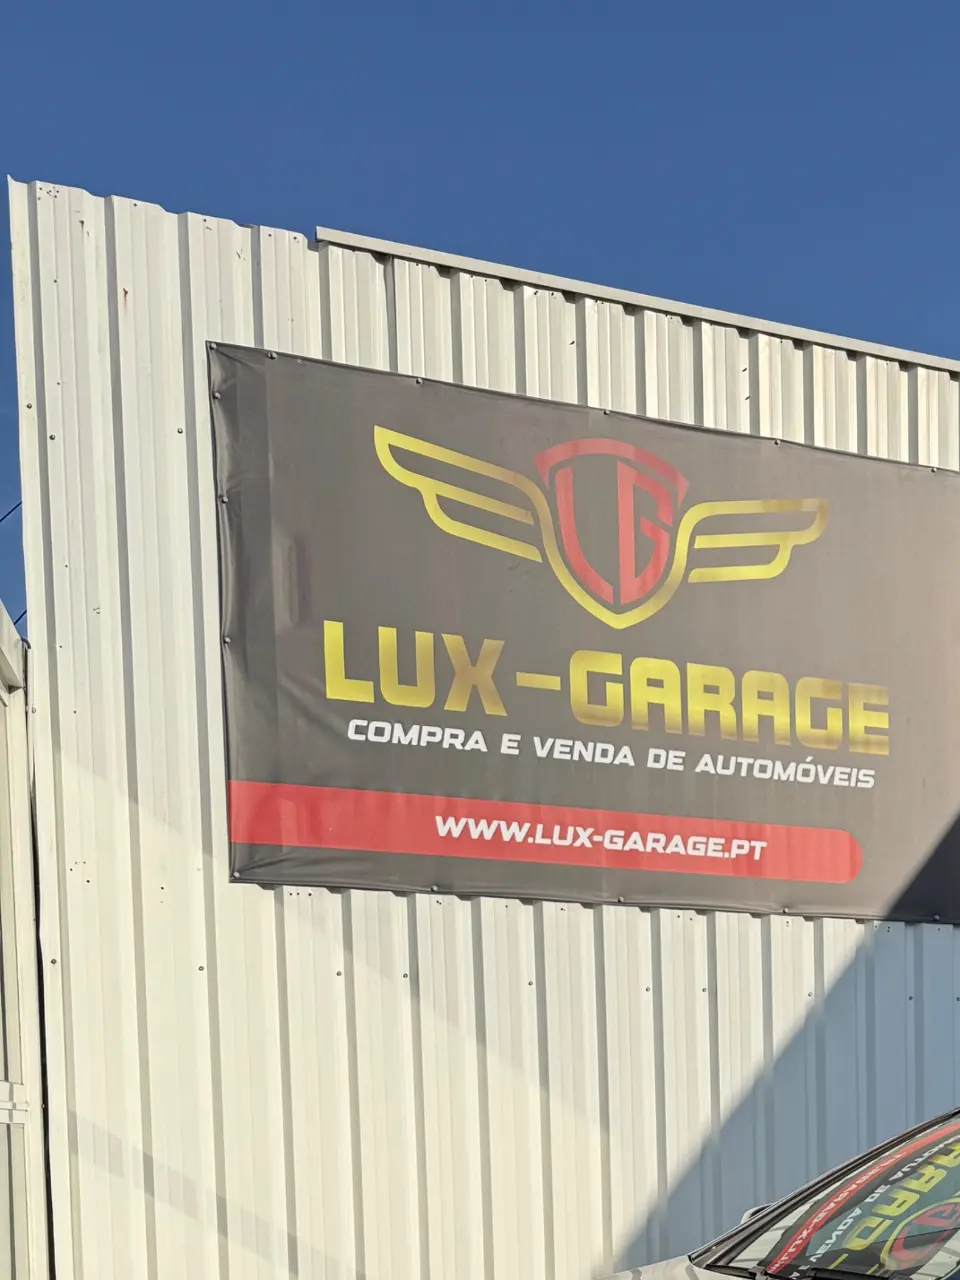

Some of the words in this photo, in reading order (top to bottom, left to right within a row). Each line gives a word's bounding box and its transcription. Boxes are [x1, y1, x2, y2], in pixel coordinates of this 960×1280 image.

[347, 719, 488, 752] COMPRA
[500, 733, 521, 755] E
[533, 737, 636, 767] VENDA
[646, 747, 686, 771] DE
[695, 754, 876, 789] AUTOMÓVEIS
[435, 815, 767, 862] WWW.LUX-GARAGE.PT
